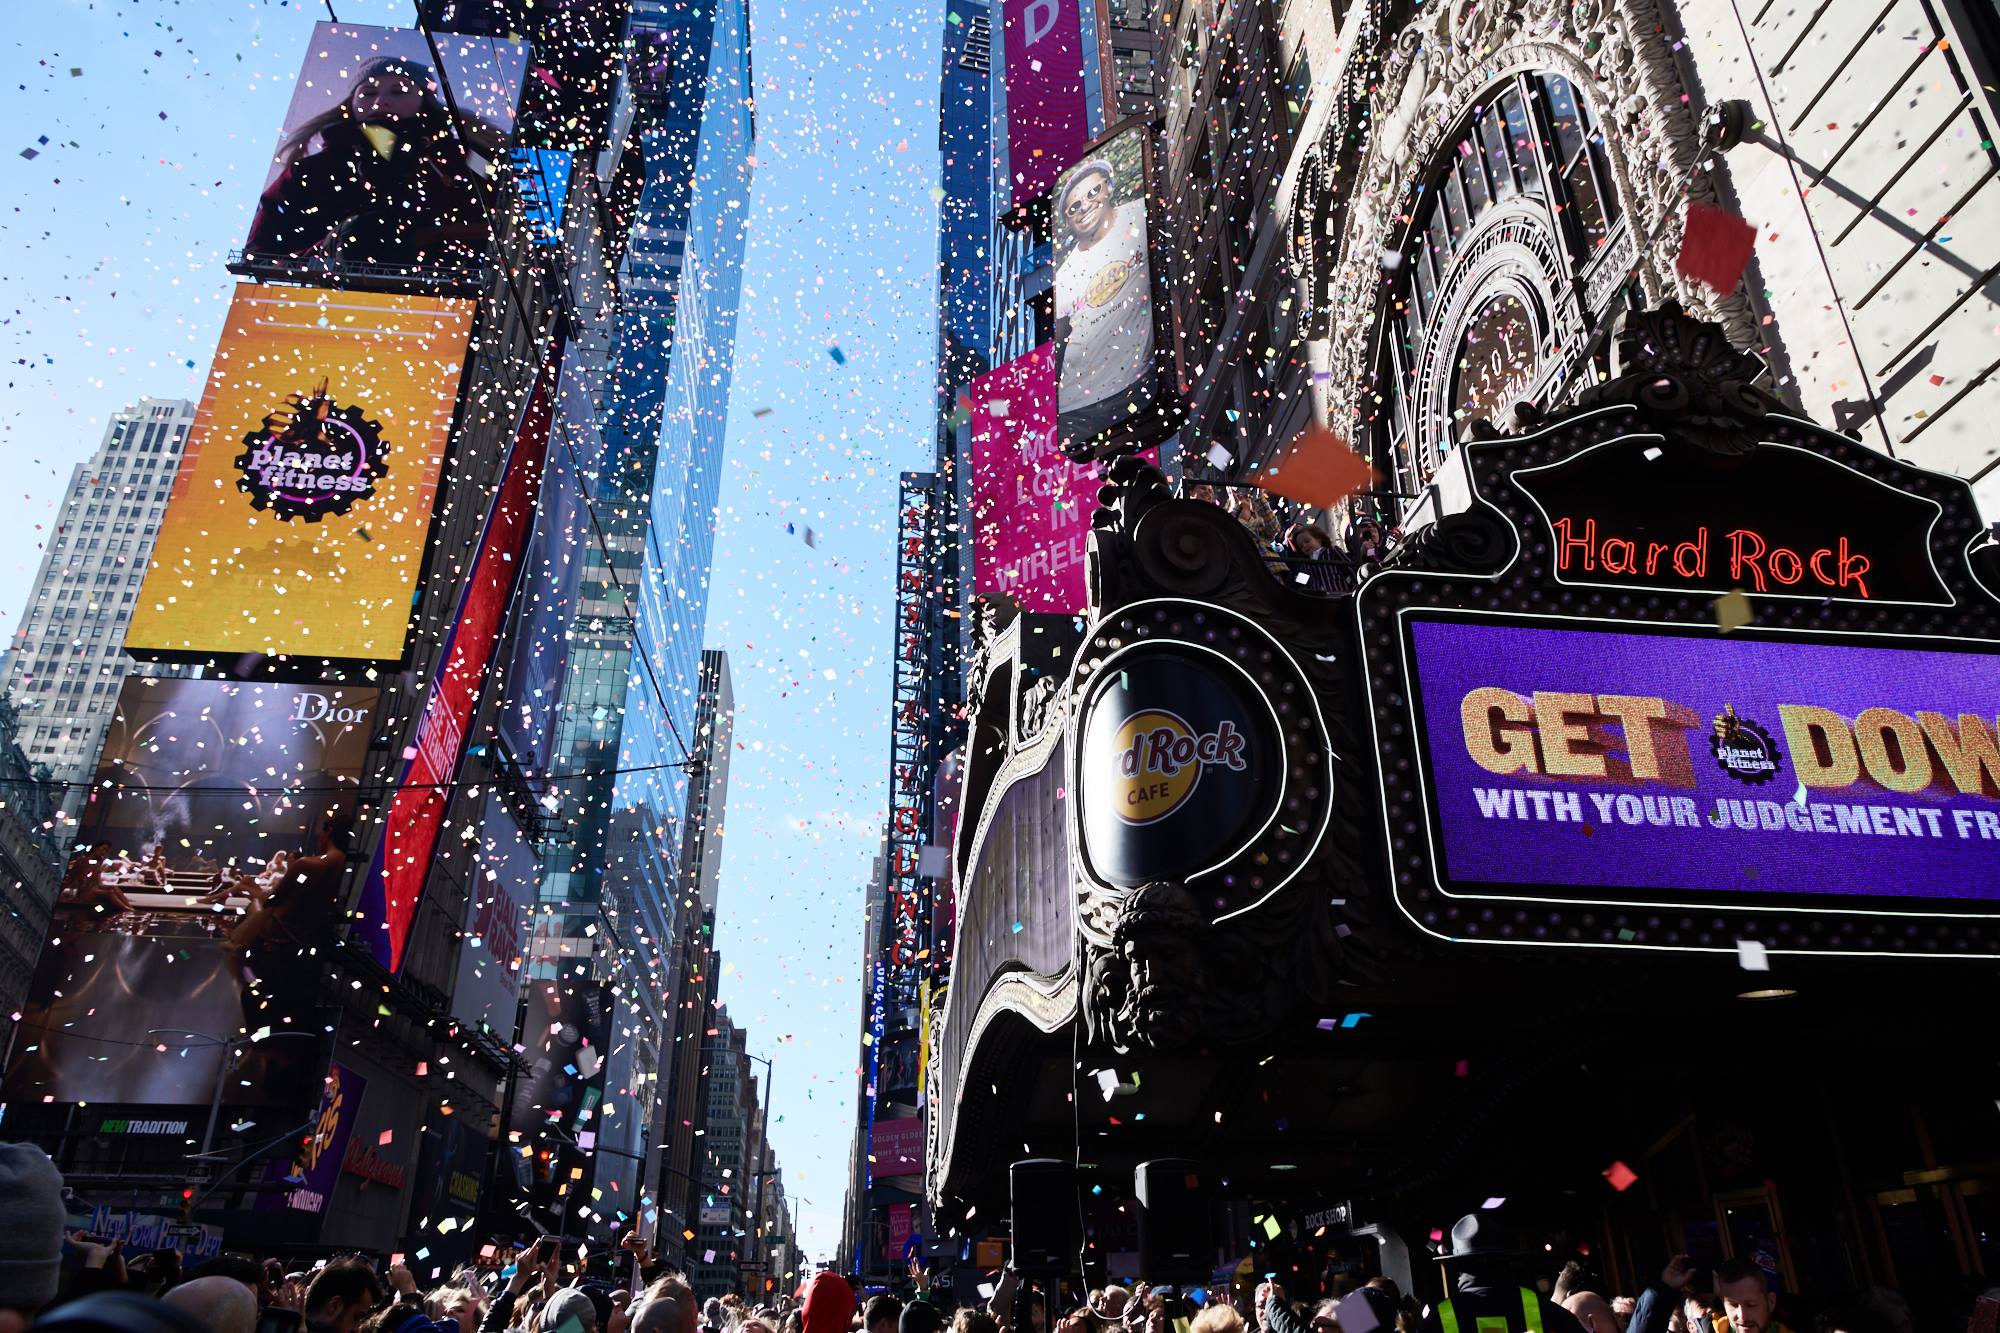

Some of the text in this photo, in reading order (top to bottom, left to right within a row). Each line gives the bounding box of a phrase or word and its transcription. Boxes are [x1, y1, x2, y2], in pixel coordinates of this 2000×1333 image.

[248, 445, 354, 474] planet
[259, 466, 369, 492] fitness
[1051, 496, 1080, 531] IN
[1553, 517, 1870, 599] Hard Rock
[294, 692, 368, 723] Dior
[1147, 721, 1247, 777] Rock
[1461, 687, 1672, 780] GET
[1717, 747, 1763, 760] planet
[1127, 782, 1169, 805] CAFE
[1472, 787, 1584, 823] WITH
[1588, 792, 1701, 828] YOUR
[1708, 798, 1943, 838] JUDGEMENT
[1305, 1205, 1347, 1231] ROCK SHOP
